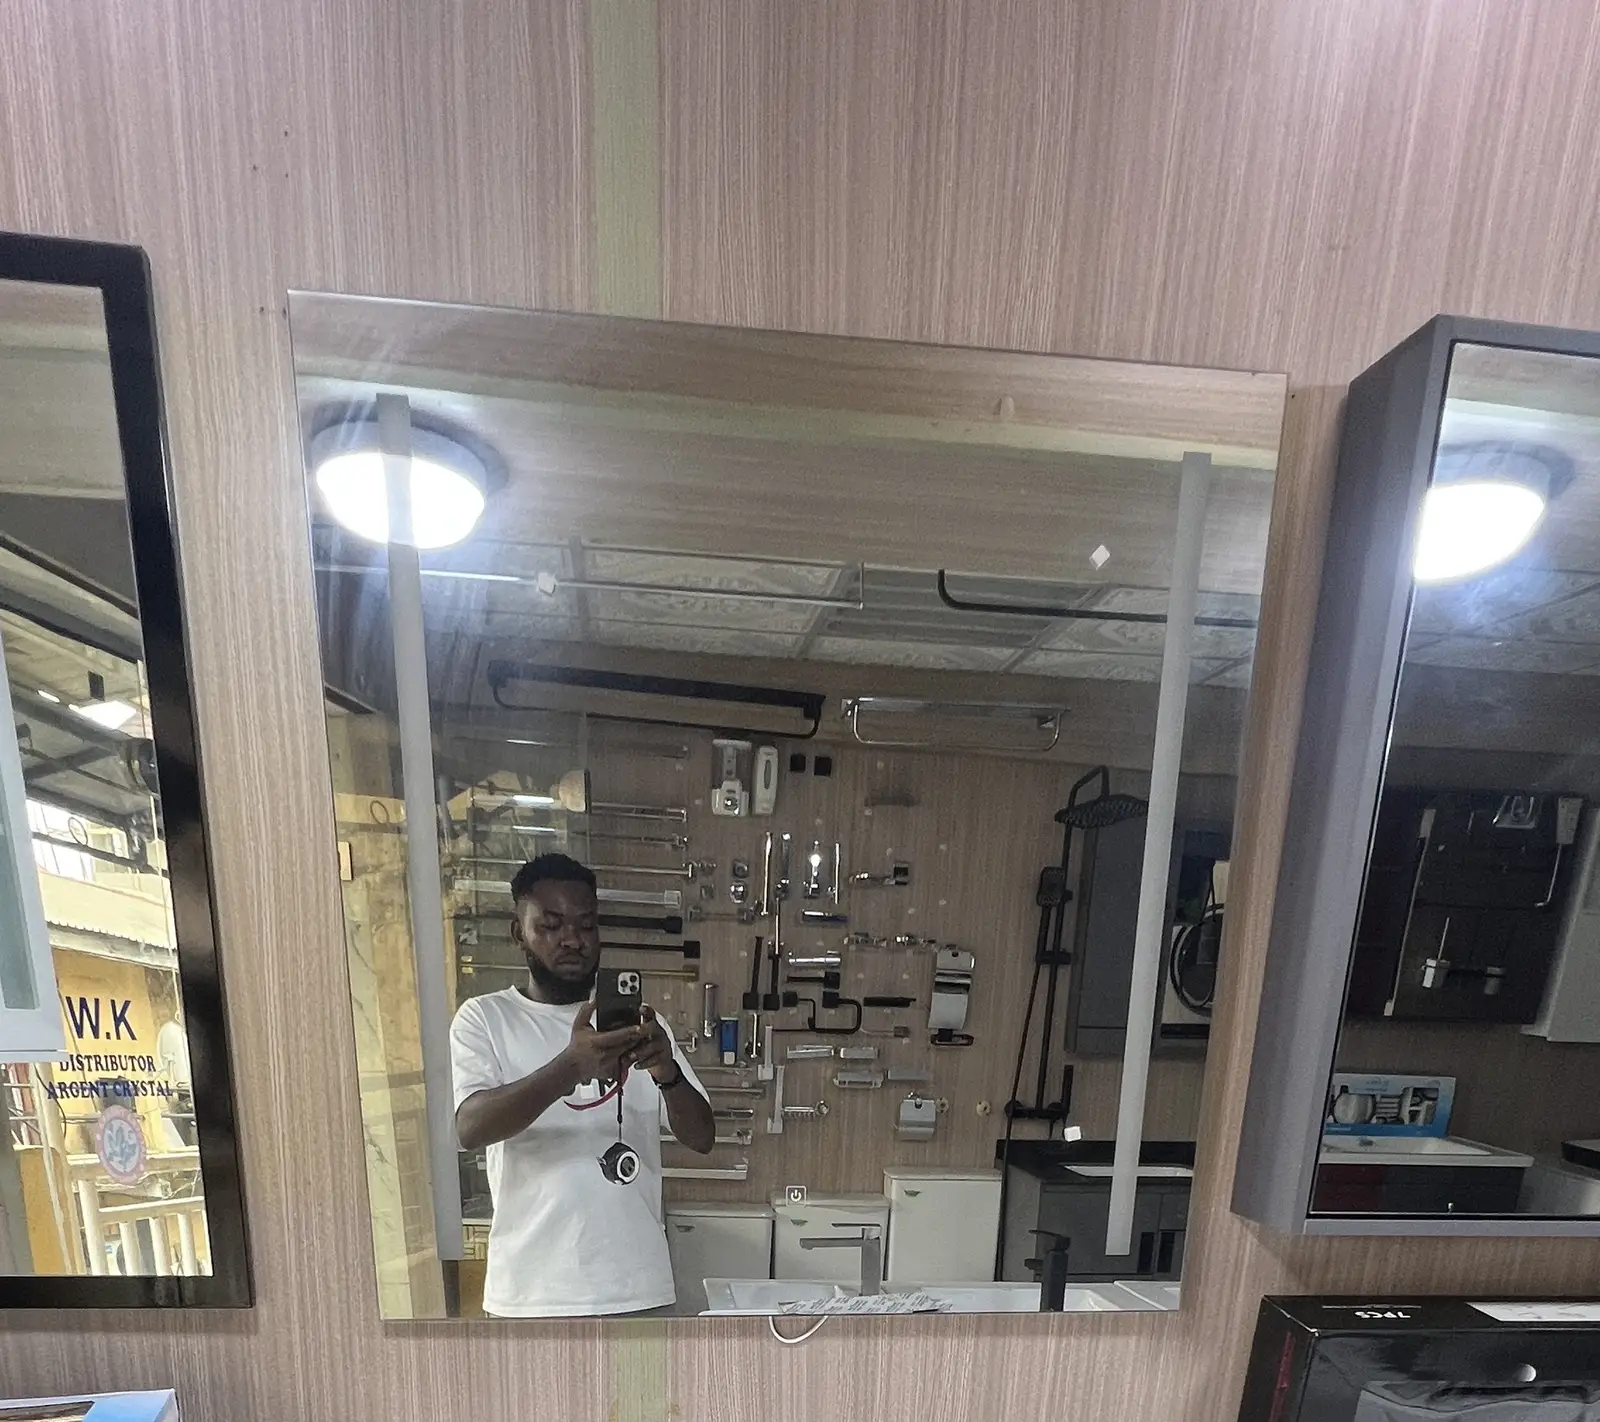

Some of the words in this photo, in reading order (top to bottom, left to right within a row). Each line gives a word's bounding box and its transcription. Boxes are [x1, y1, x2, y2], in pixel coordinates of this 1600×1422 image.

[66, 996, 137, 1041] W.K
[60, 1054, 156, 1073] DISTRIBUTOR
[48, 1080, 108, 1099] ARGENT
[113, 1080, 173, 1097] CRYSTAL
